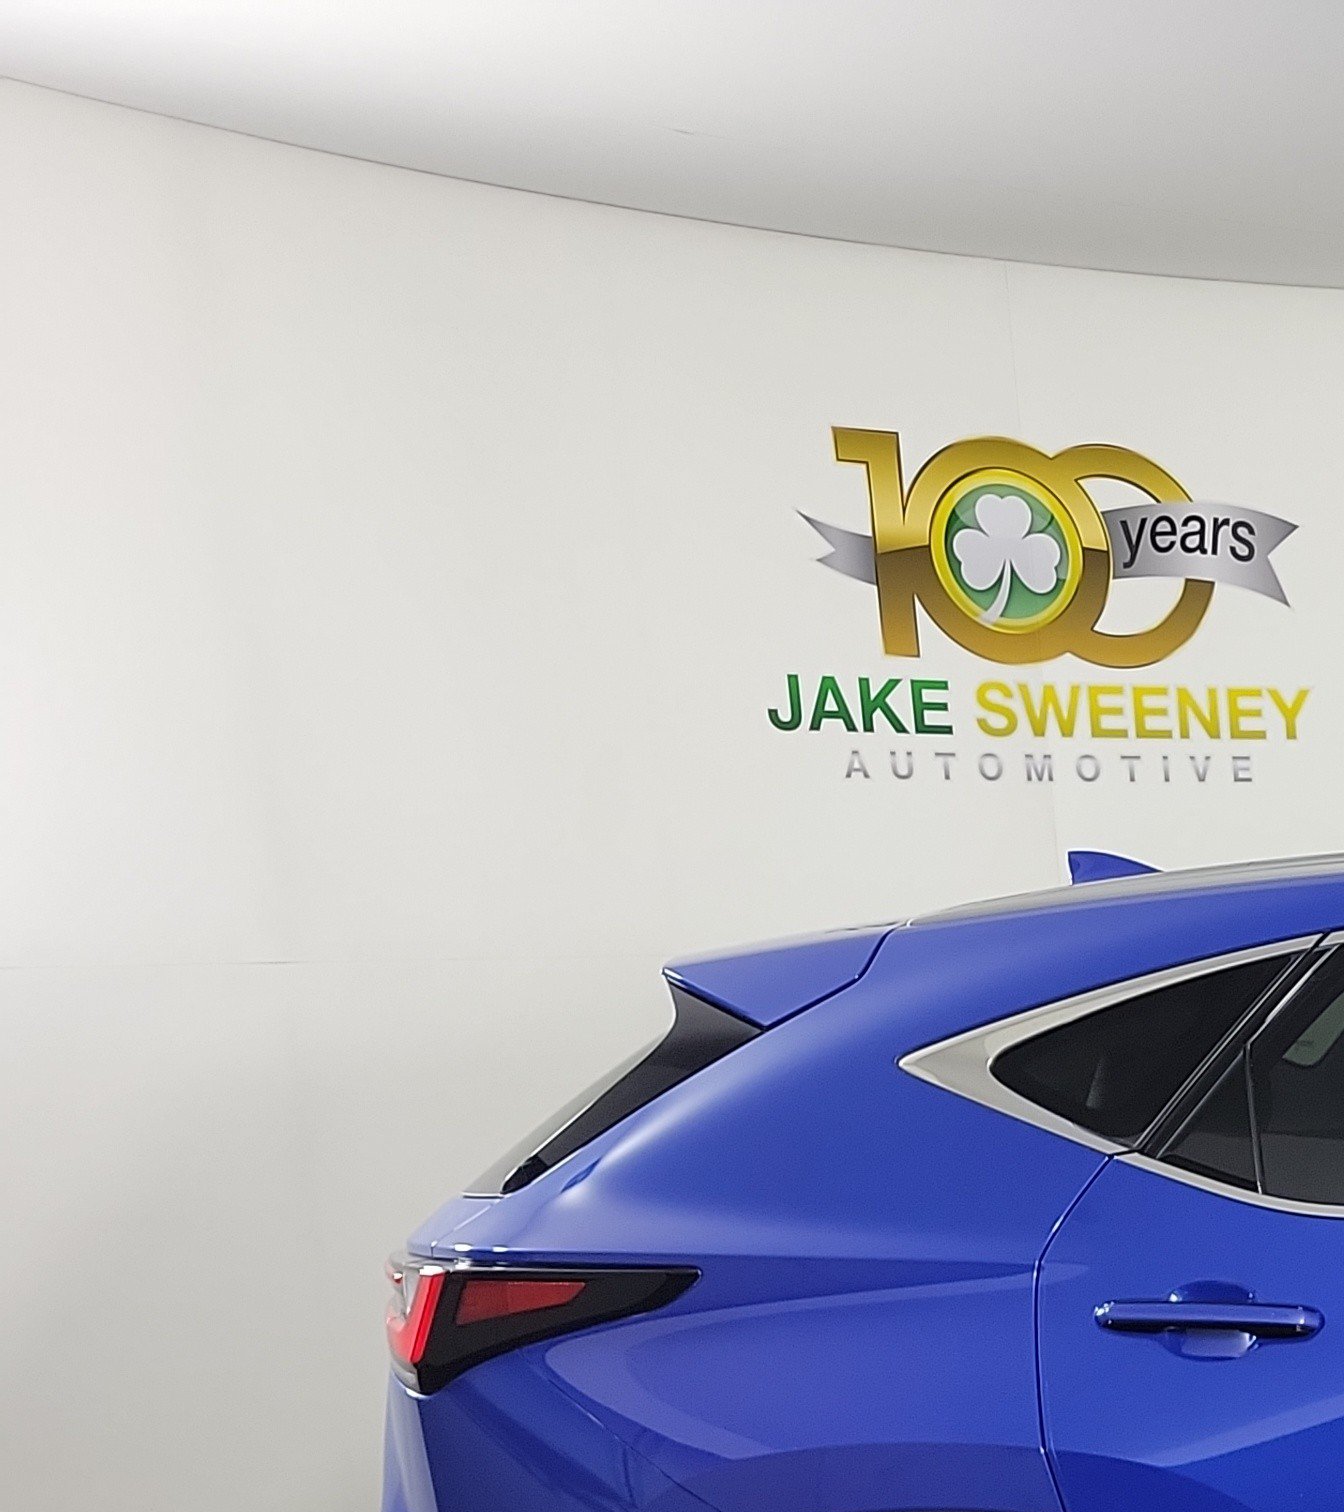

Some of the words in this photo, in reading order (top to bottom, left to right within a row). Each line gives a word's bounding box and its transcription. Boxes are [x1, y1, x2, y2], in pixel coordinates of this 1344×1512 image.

[1118, 514, 1258, 570] years
[766, 673, 955, 736] JAKE
[975, 680, 1310, 741] SWEENEY
[844, 749, 1254, 783] AUTOMOTIVE
